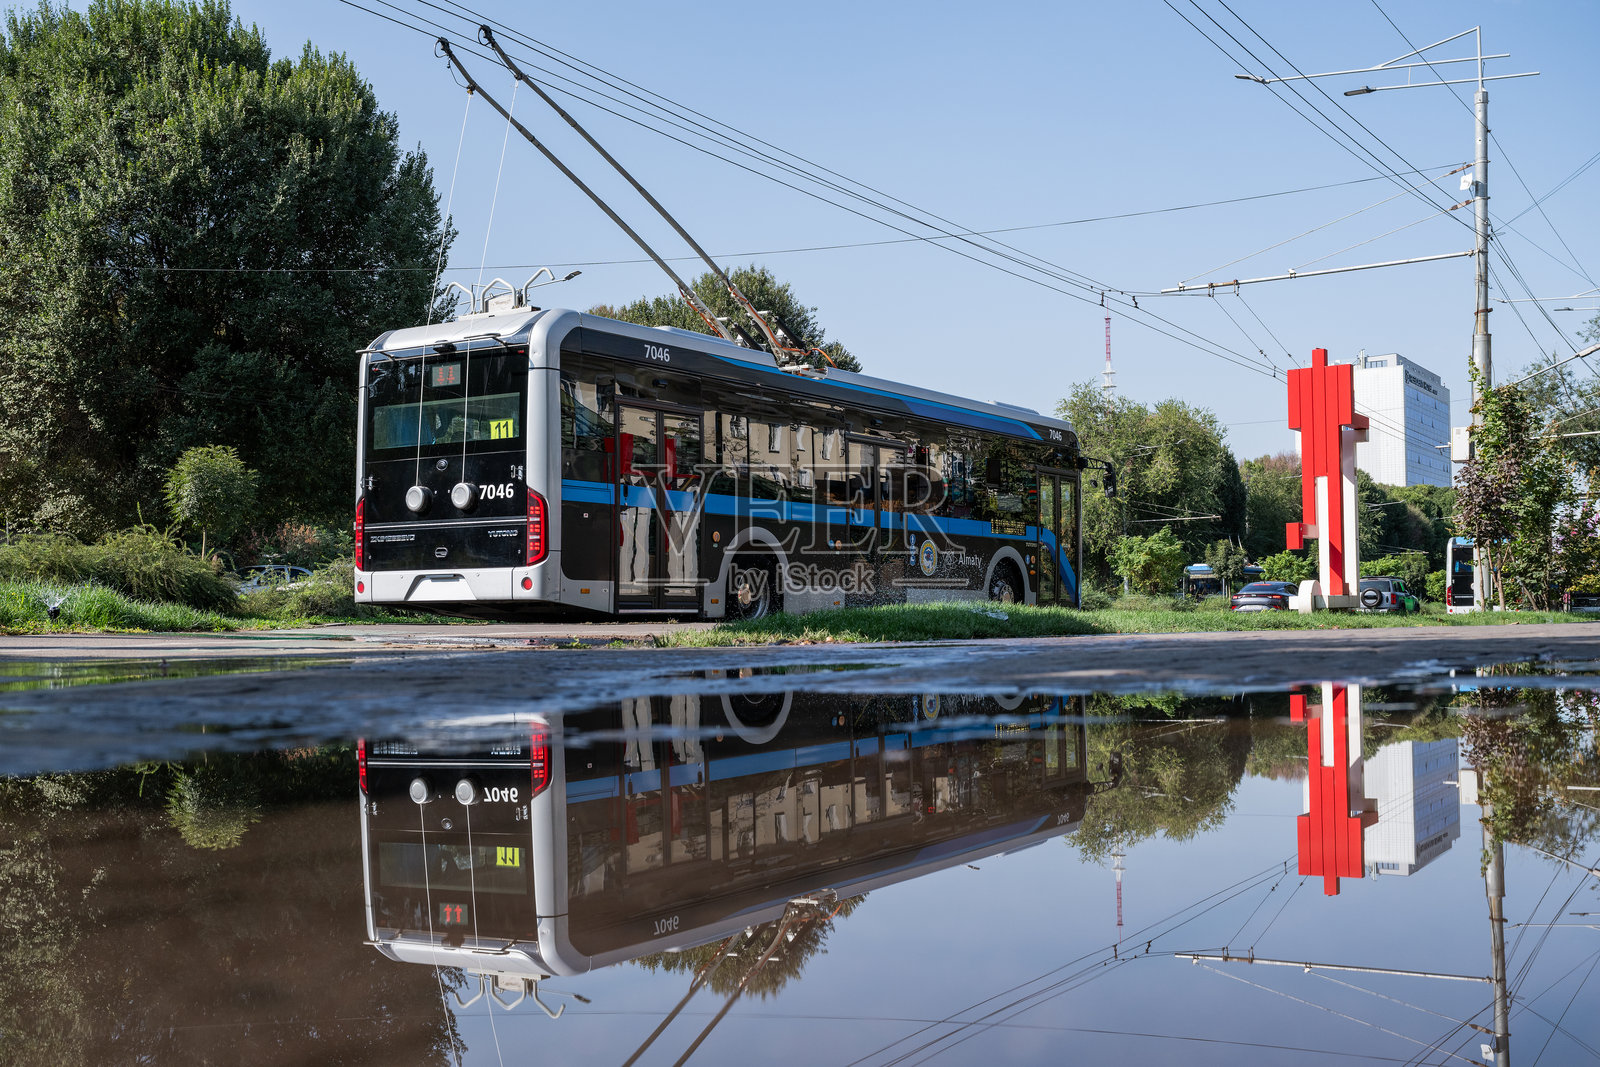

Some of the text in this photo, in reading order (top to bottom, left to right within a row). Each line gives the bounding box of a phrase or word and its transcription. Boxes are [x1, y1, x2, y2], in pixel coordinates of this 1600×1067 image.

[644, 344, 670, 362] 7046
[494, 421, 509, 438] 11
[1049, 429, 1062, 441] 7046
[479, 483, 514, 500] 7046
[958, 552, 982, 569] Almaty
